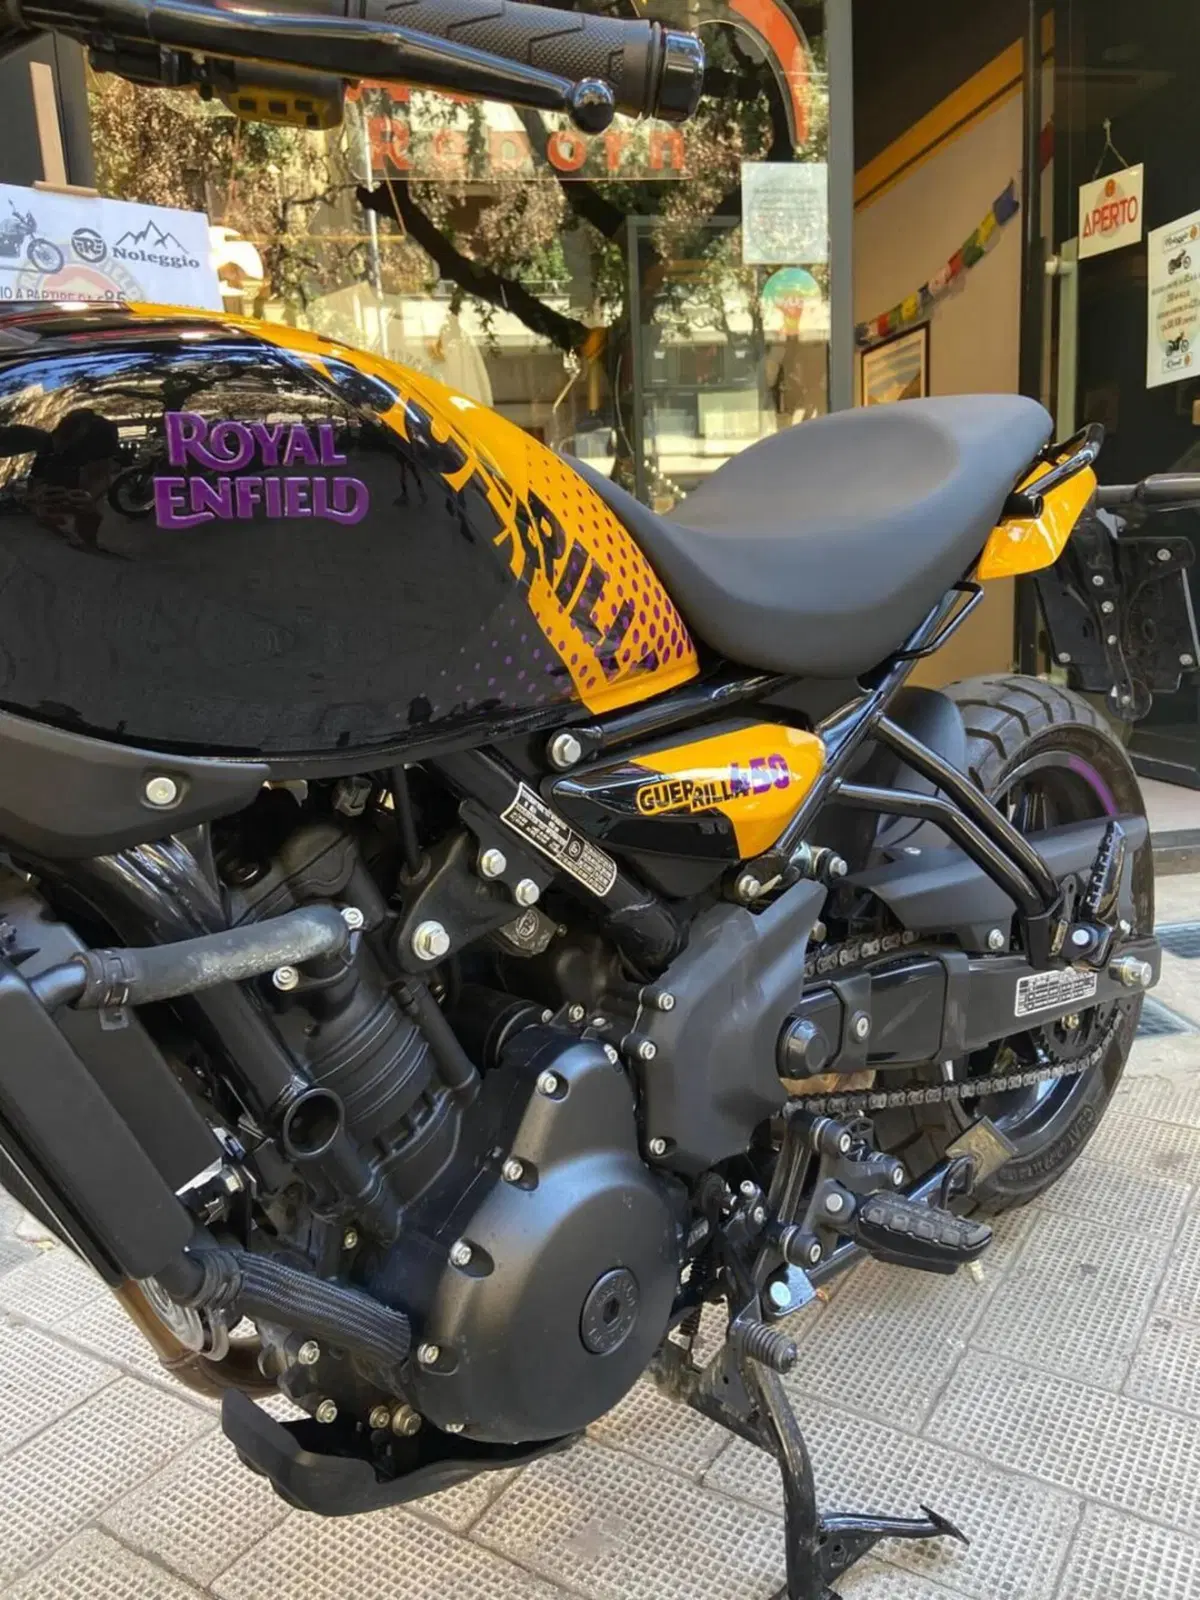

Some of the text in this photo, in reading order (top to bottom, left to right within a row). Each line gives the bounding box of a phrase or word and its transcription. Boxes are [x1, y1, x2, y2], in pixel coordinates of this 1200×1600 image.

[1083, 196, 1139, 239] APERTO
[112, 247, 200, 269] Noleggio
[165, 411, 347, 471] ROYAL
[153, 476, 369, 528] ENFIELD
[638, 753, 791, 811] GUERRILLA 450
